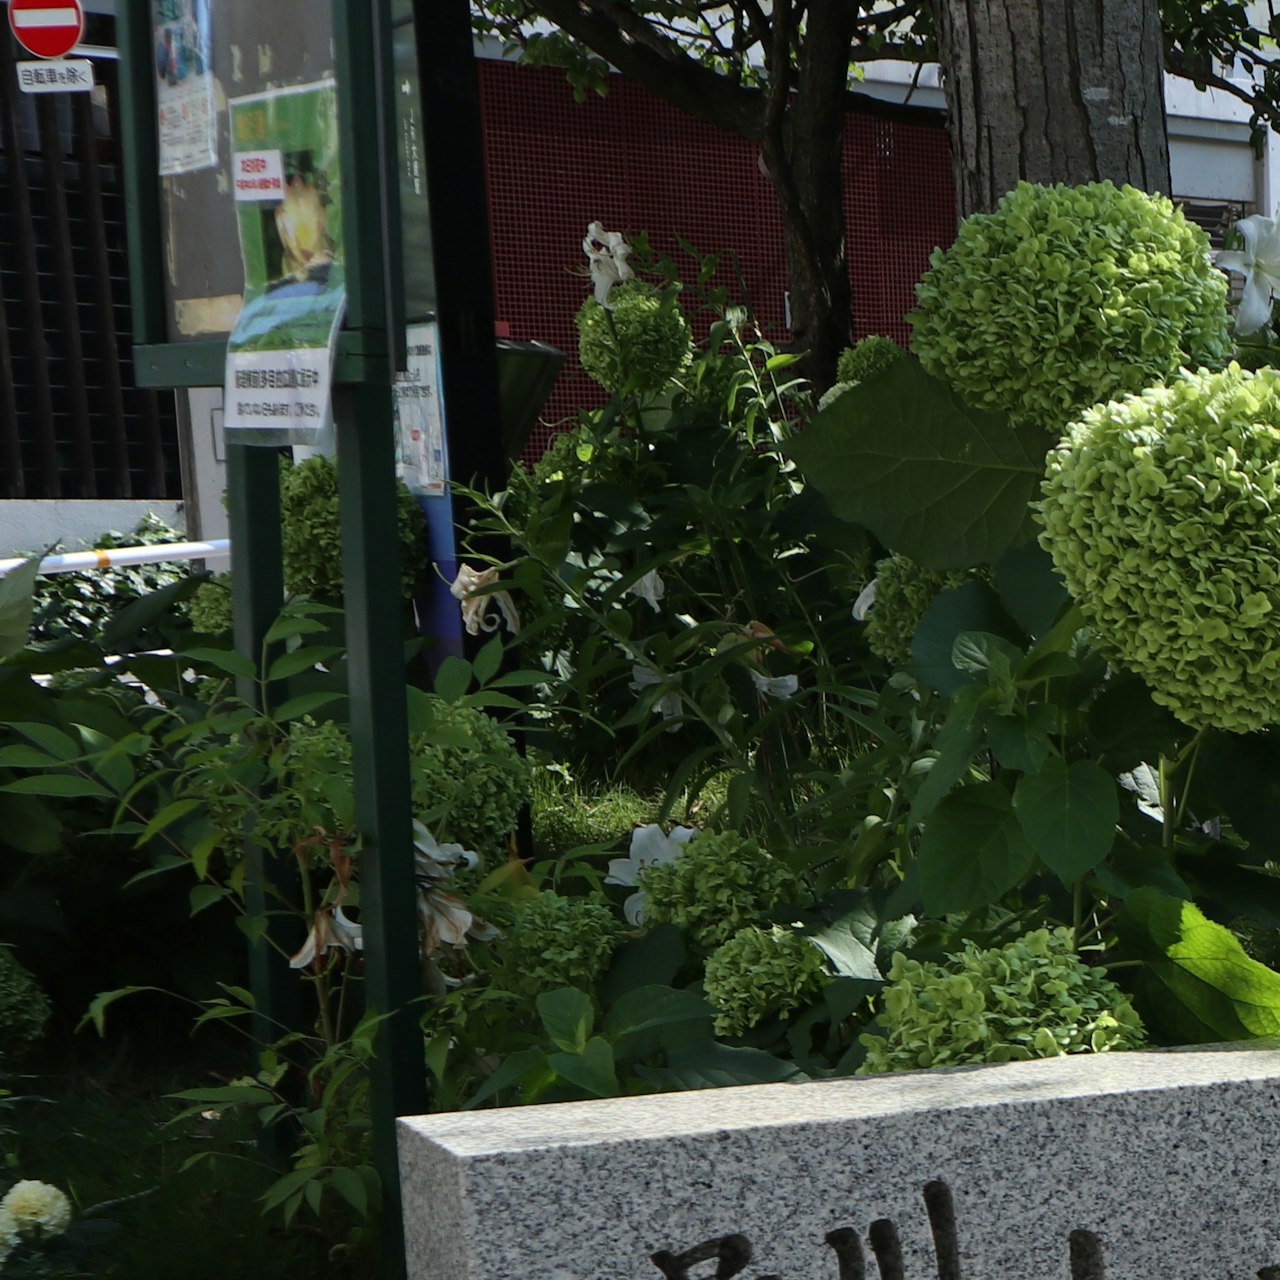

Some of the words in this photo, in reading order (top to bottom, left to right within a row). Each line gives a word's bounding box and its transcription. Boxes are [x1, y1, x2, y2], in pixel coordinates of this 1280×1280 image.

[21, 66, 87, 85] 自転車を除く
